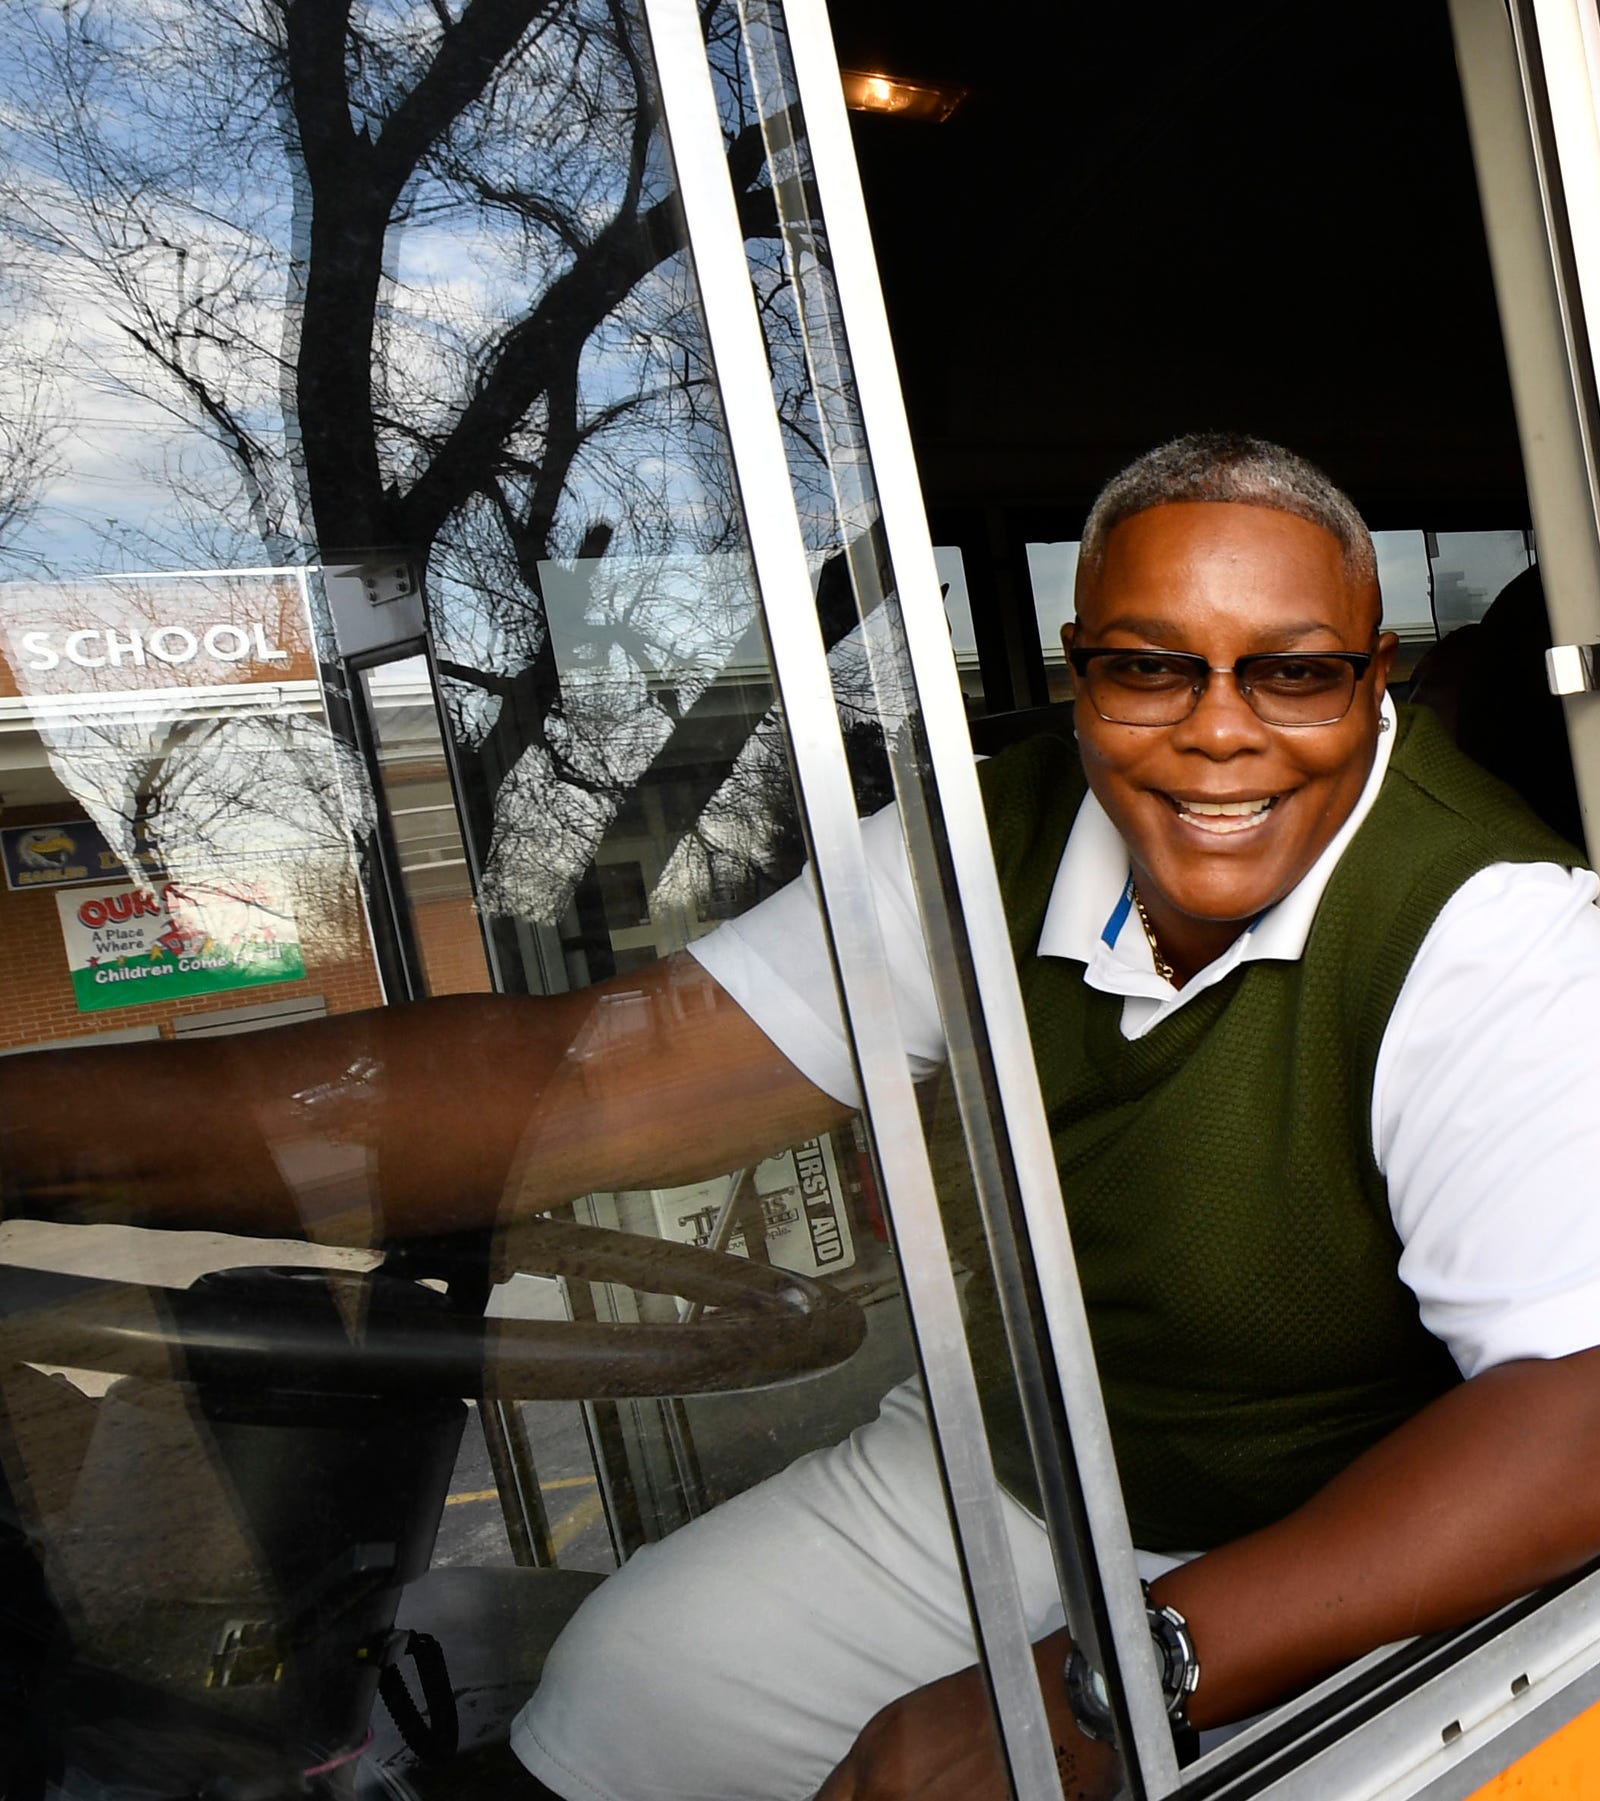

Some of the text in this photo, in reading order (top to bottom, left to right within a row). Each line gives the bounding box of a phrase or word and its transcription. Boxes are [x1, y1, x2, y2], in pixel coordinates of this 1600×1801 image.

[21, 623, 288, 671] SCHOOL
[79, 888, 161, 928] OUR
[92, 927, 145, 943] A Place
[96, 939, 145, 953] Where
[95, 955, 229, 984] Children Come
[811, 1217, 842, 1261] AID
